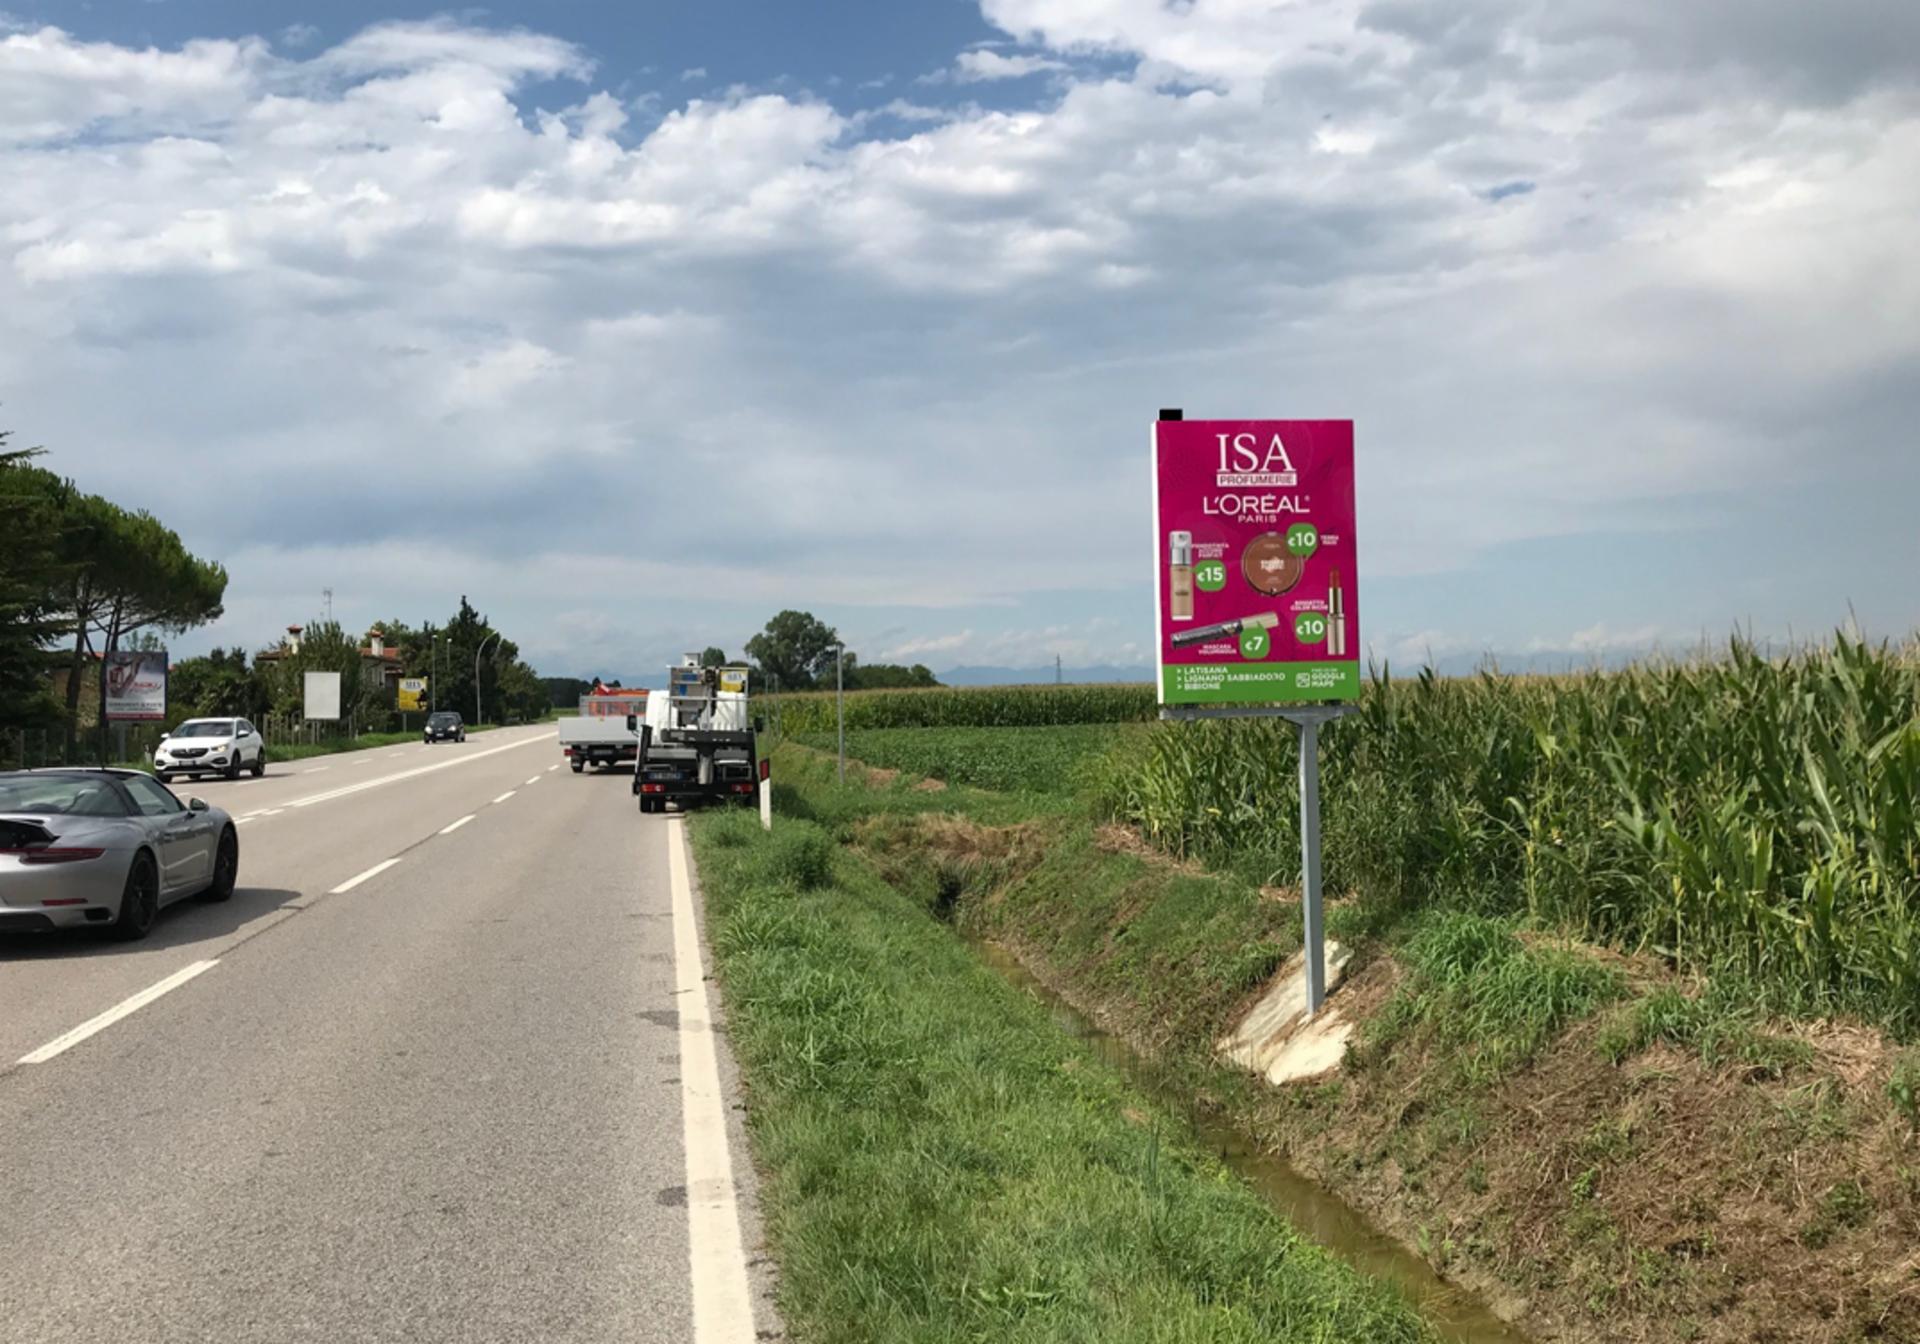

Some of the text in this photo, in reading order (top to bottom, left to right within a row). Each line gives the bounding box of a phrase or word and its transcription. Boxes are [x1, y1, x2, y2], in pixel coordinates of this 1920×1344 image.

[1215, 433, 1297, 473] ISA
[1219, 475, 1295, 485] PROFUMERIE
[1203, 493, 1310, 515] L'ORÉAL
[1238, 514, 1277, 524] PARIS
[1287, 532, 1316, 547] €10
[1197, 567, 1224, 582] €15
[1296, 620, 1324, 635] €10
[1244, 636, 1264, 651] €7
[1184, 674, 1225, 682] LIGNANO
[1311, 672, 1346, 680] GOOGLE
[1184, 682, 1220, 690] BIBIONE
[1311, 680, 1334, 688] MAPS
